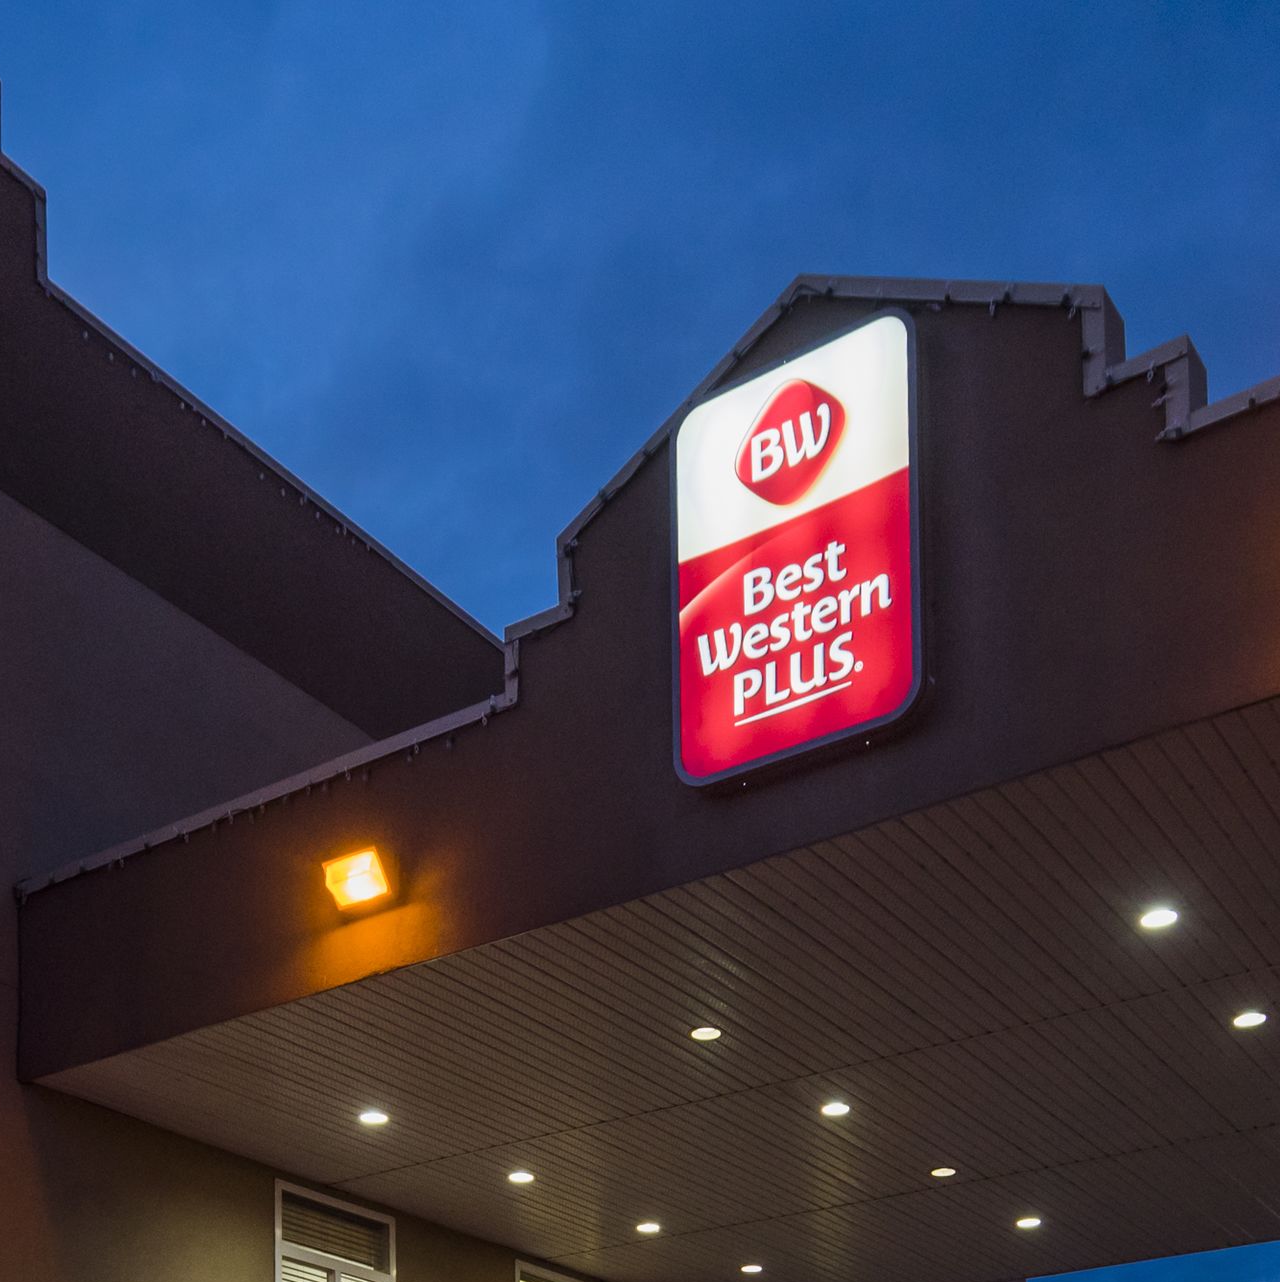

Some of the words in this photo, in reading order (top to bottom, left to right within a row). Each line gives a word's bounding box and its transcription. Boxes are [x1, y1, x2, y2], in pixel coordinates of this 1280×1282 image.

[749, 402, 831, 484] BW
[742, 540, 848, 617] Best
[697, 573, 893, 677] Western
